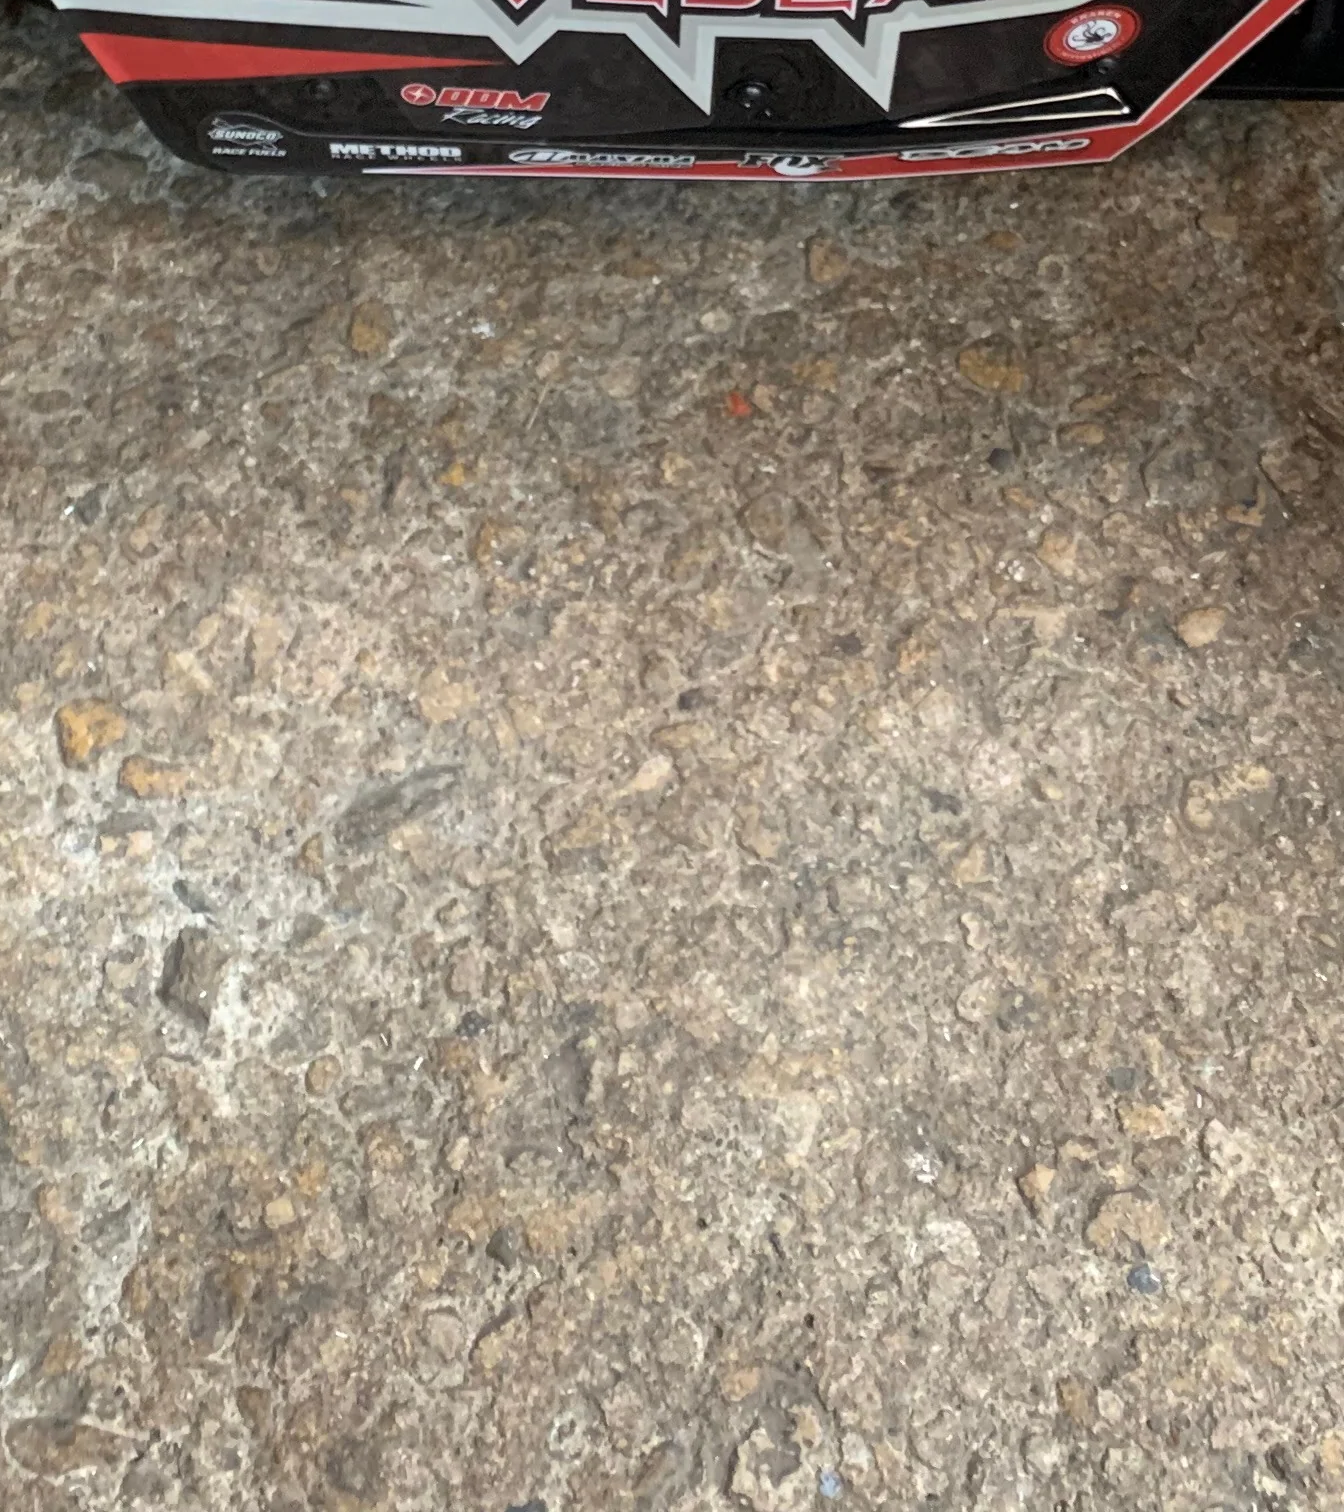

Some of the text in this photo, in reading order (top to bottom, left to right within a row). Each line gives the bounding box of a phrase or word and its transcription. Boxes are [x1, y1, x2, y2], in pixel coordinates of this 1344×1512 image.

[440, 106, 544, 130] Racing
[214, 129, 278, 141] SUNOCO
[329, 143, 462, 157] METHOD
